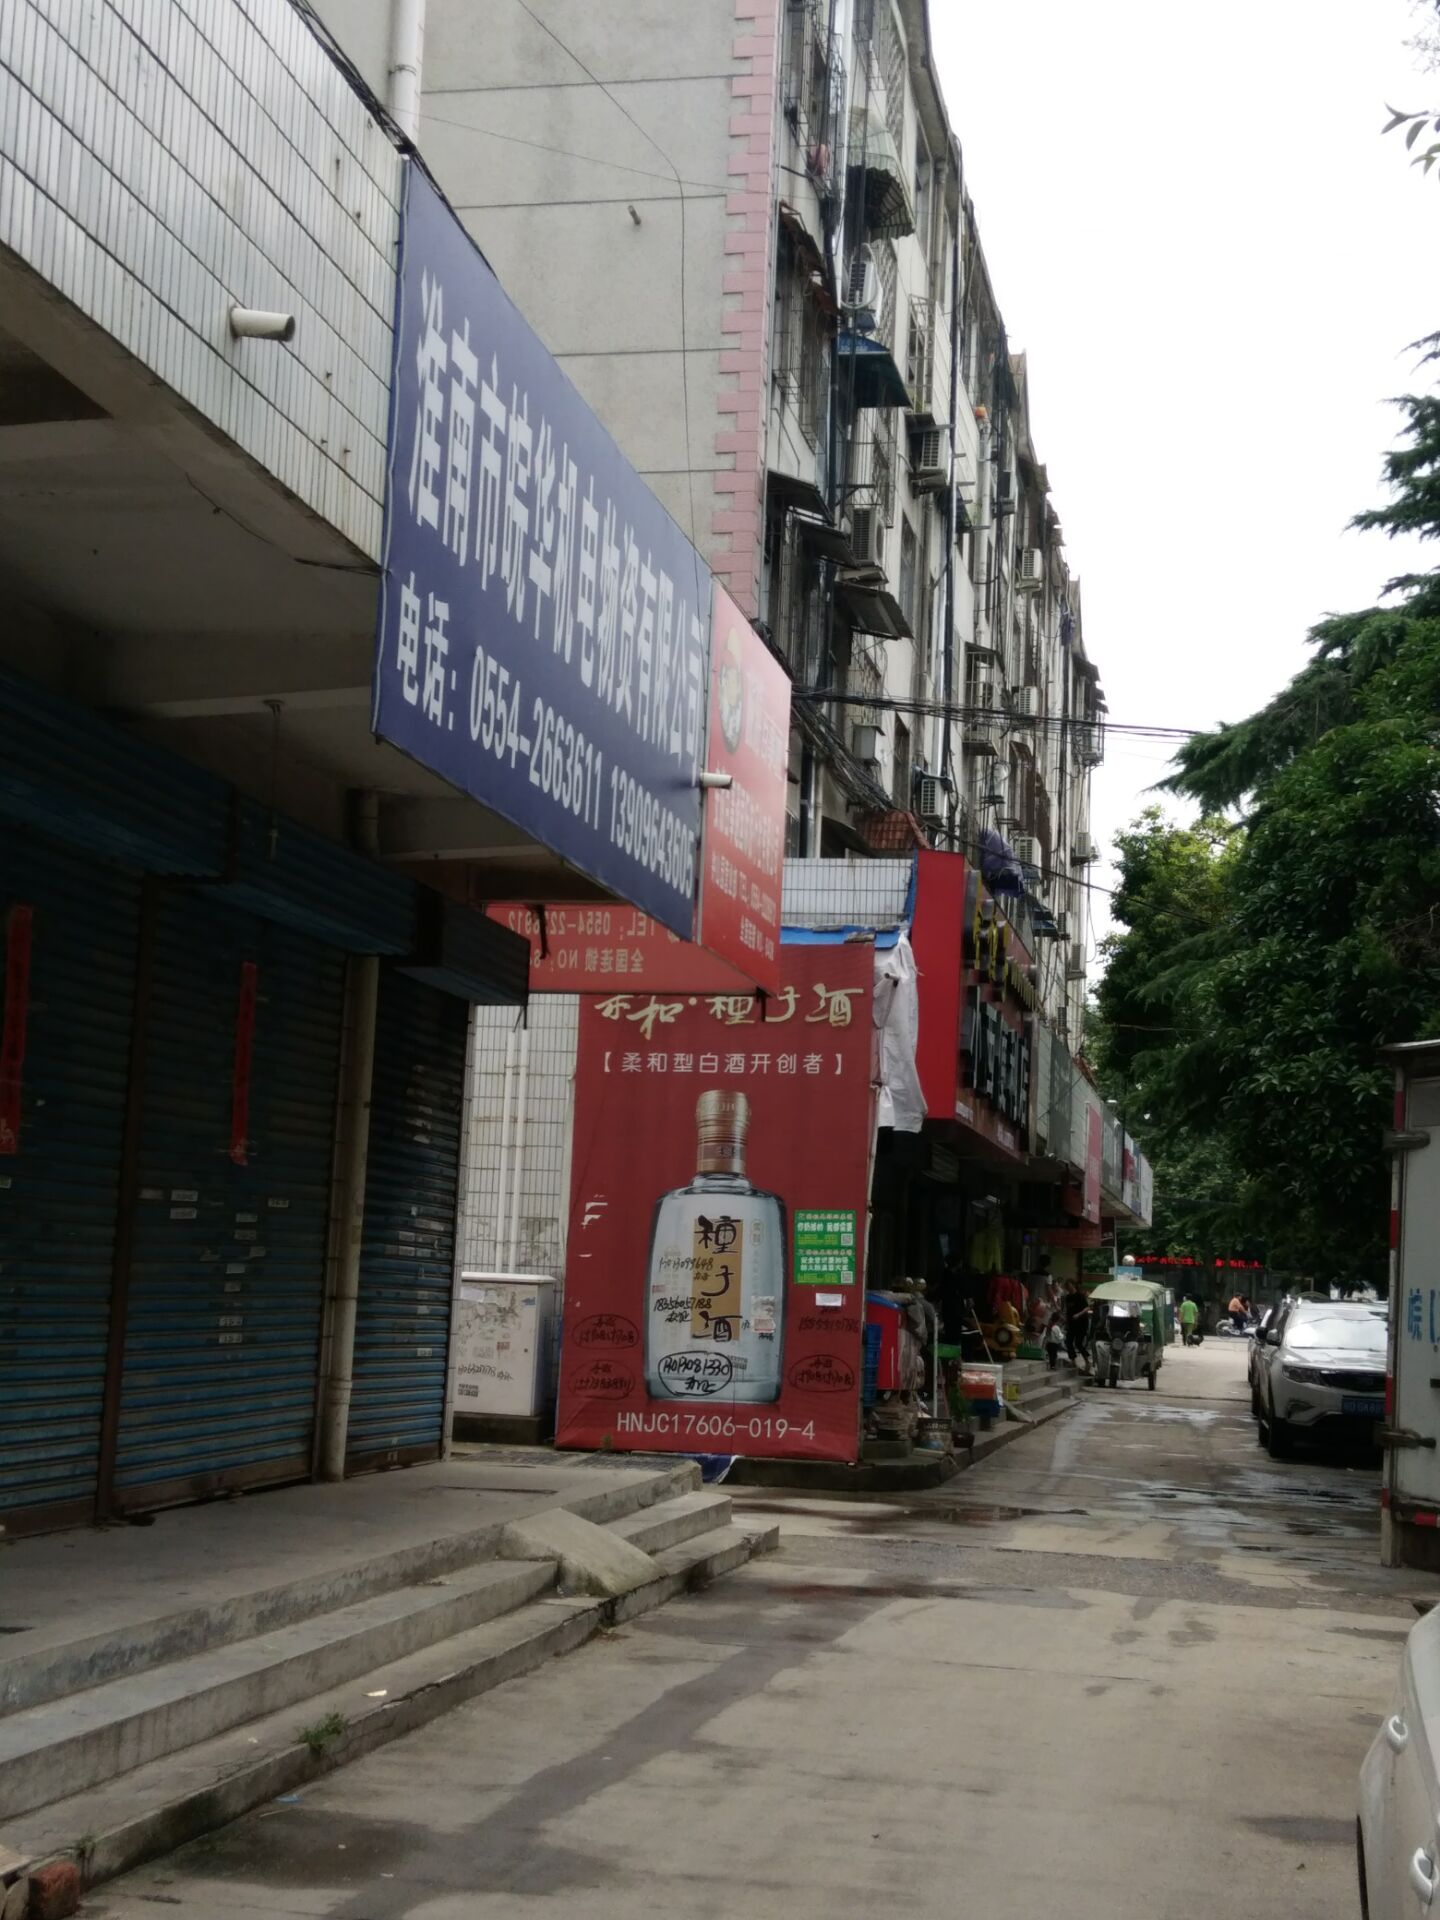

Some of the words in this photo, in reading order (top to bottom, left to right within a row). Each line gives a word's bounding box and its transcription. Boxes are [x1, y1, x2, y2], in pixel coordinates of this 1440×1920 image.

[408, 265, 703, 786] 淮南市皖华机电物资有限公司
[470, 645, 602, 830] 0554-2663611
[610, 765, 694, 899] 13909643605
[603, 1052, 843, 1076] 【柔和型白酒开创者】
[617, 1411, 816, 1440] HNJC17606-019-4
